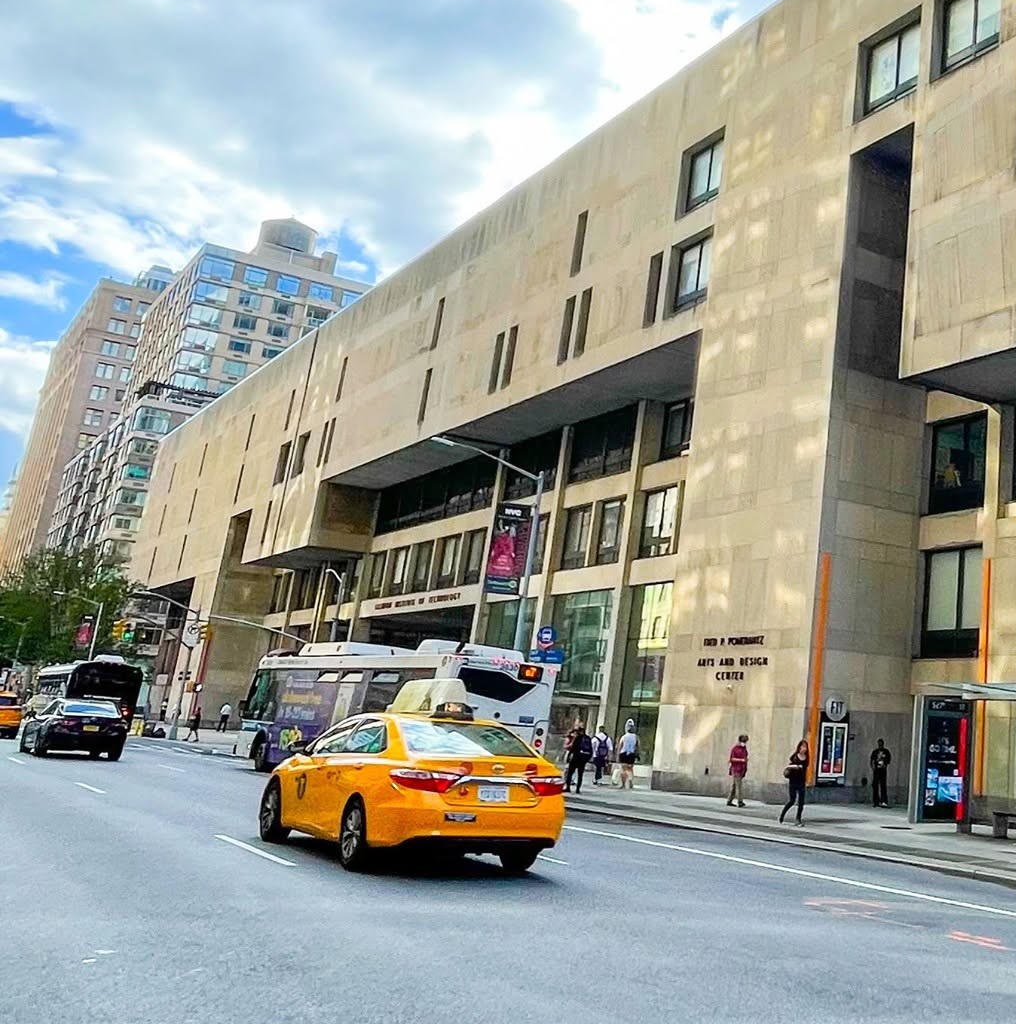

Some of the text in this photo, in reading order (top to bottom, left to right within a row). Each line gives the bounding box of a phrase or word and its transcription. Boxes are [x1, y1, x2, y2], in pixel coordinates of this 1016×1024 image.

[697, 657, 768, 667] ARTS AND DESIGN
[716, 671, 744, 680] CENTER
[831, 701, 845, 714] FIT
